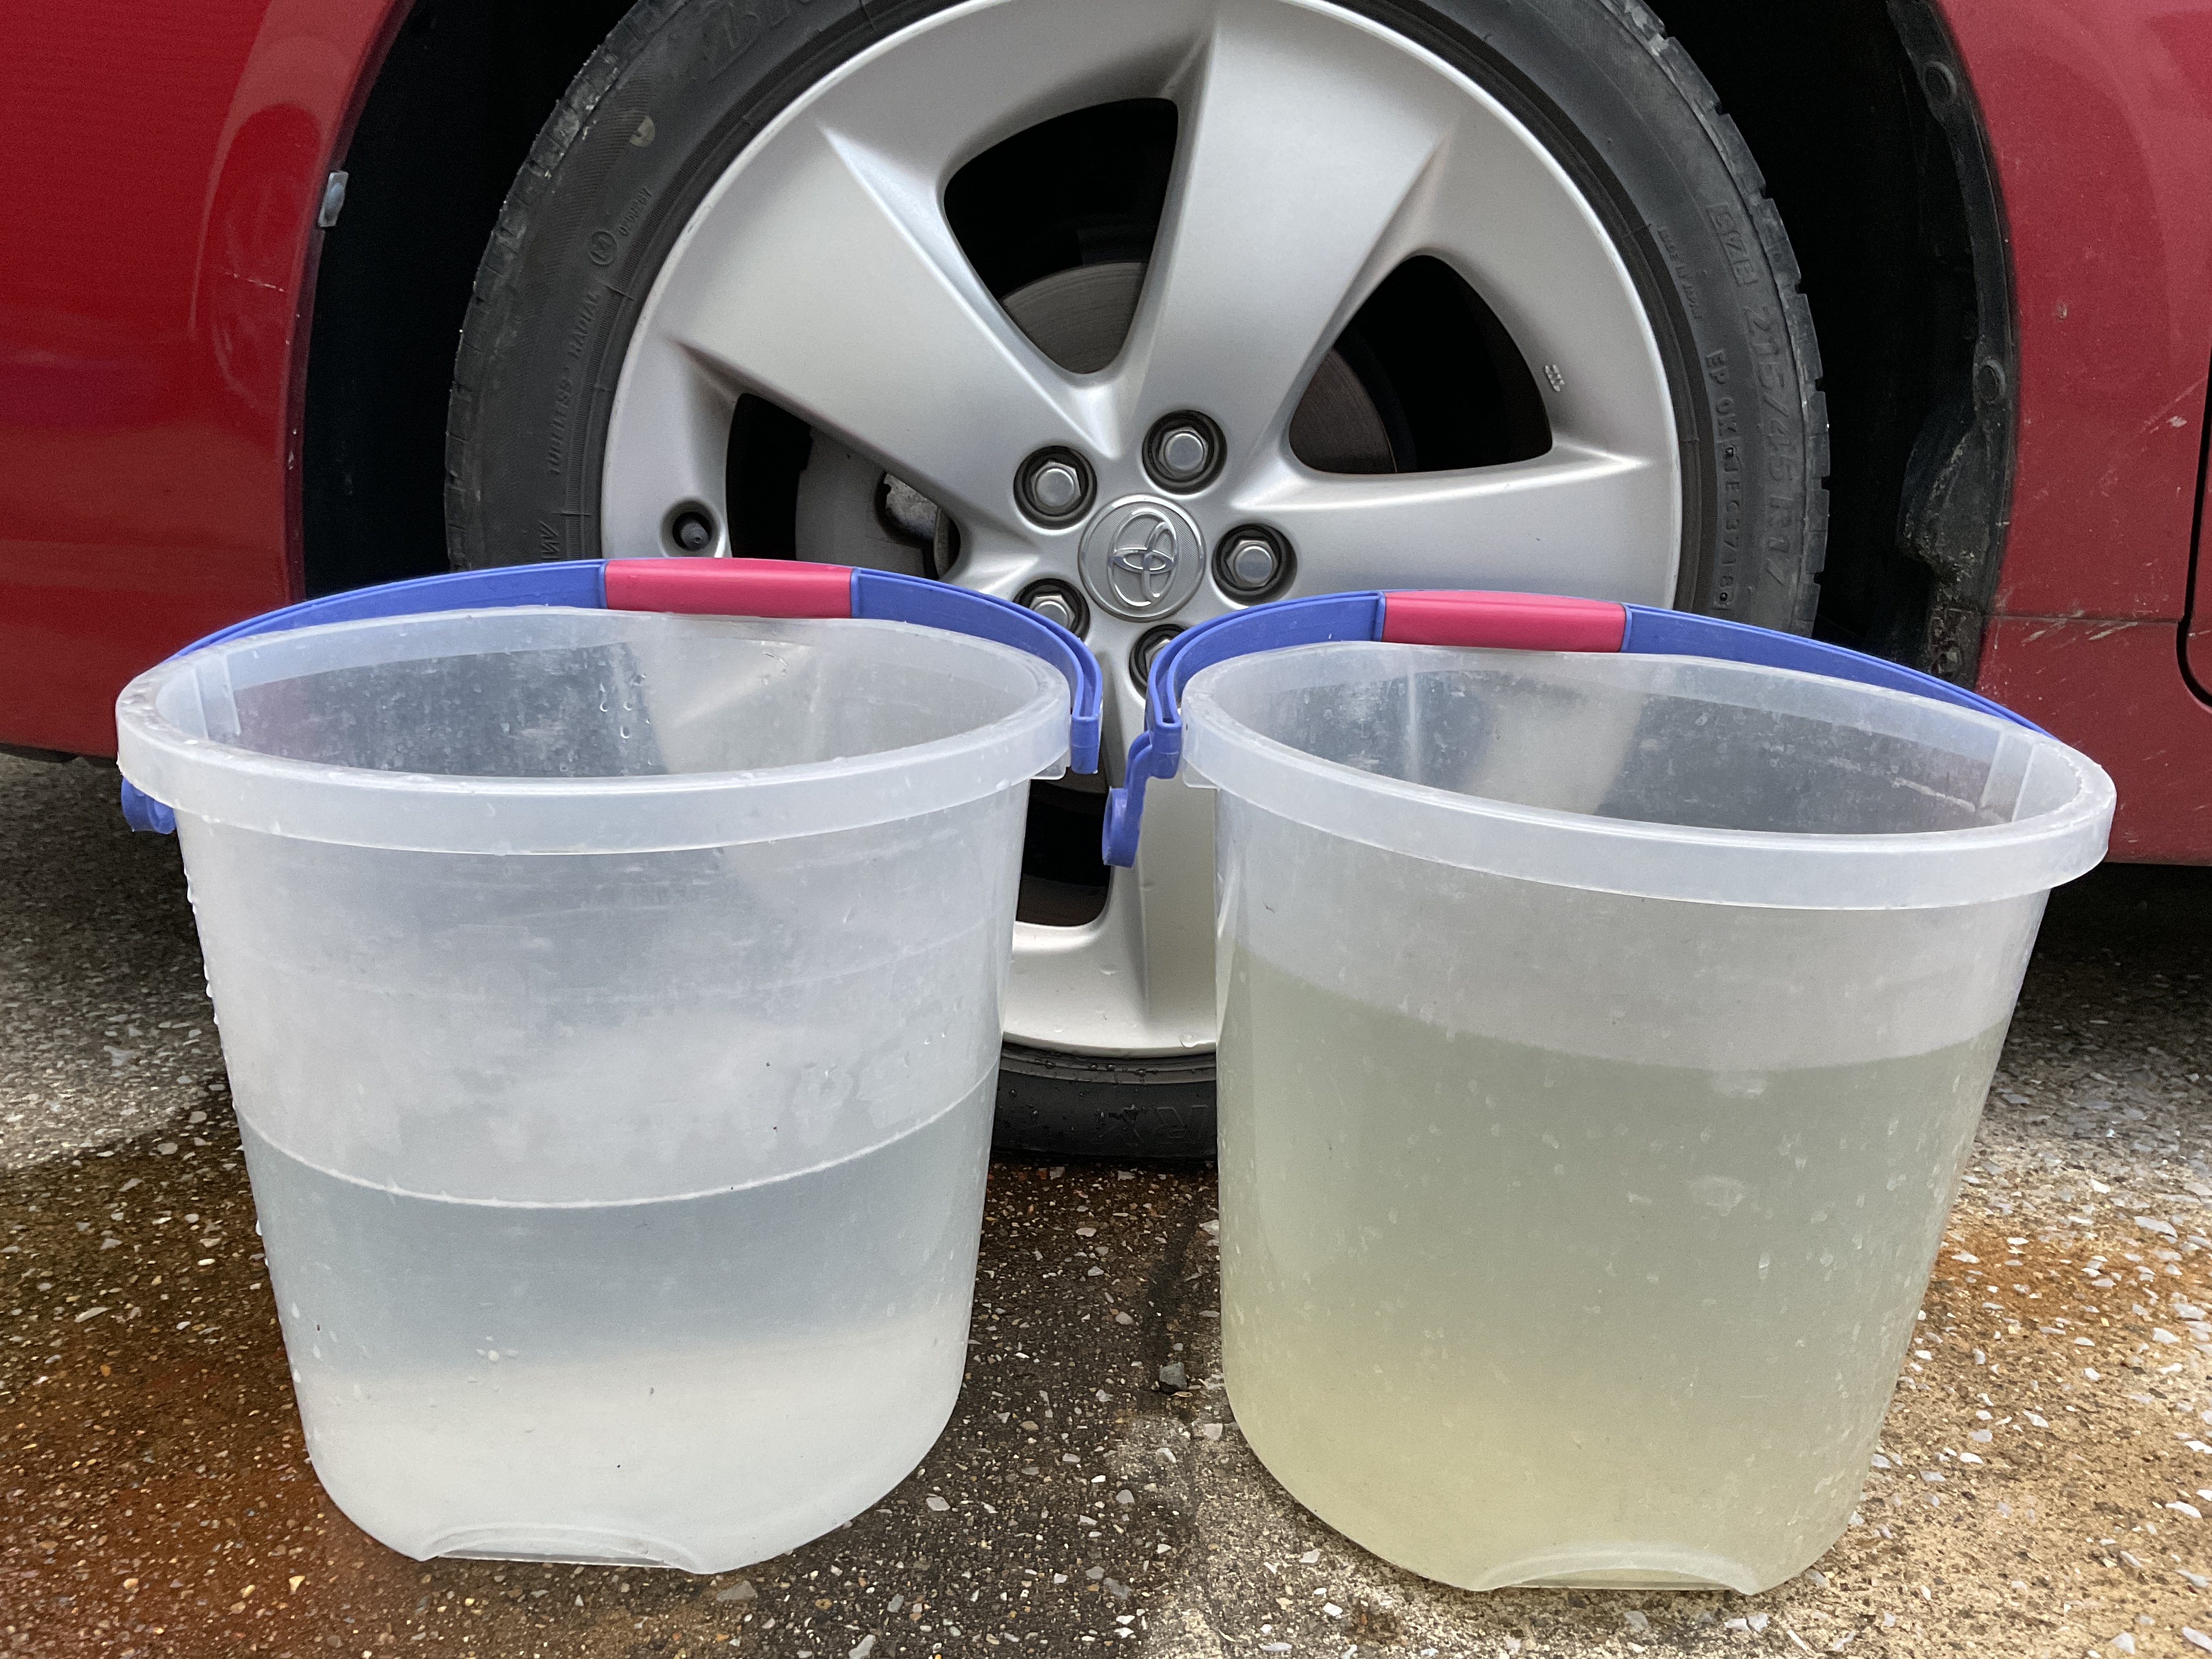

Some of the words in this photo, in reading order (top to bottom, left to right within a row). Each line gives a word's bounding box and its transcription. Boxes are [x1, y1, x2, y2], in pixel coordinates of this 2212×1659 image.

[1715, 211, 1756, 279] SIZE
[569, 291, 601, 359] RADIAL
[1704, 347, 1730, 386] EP
